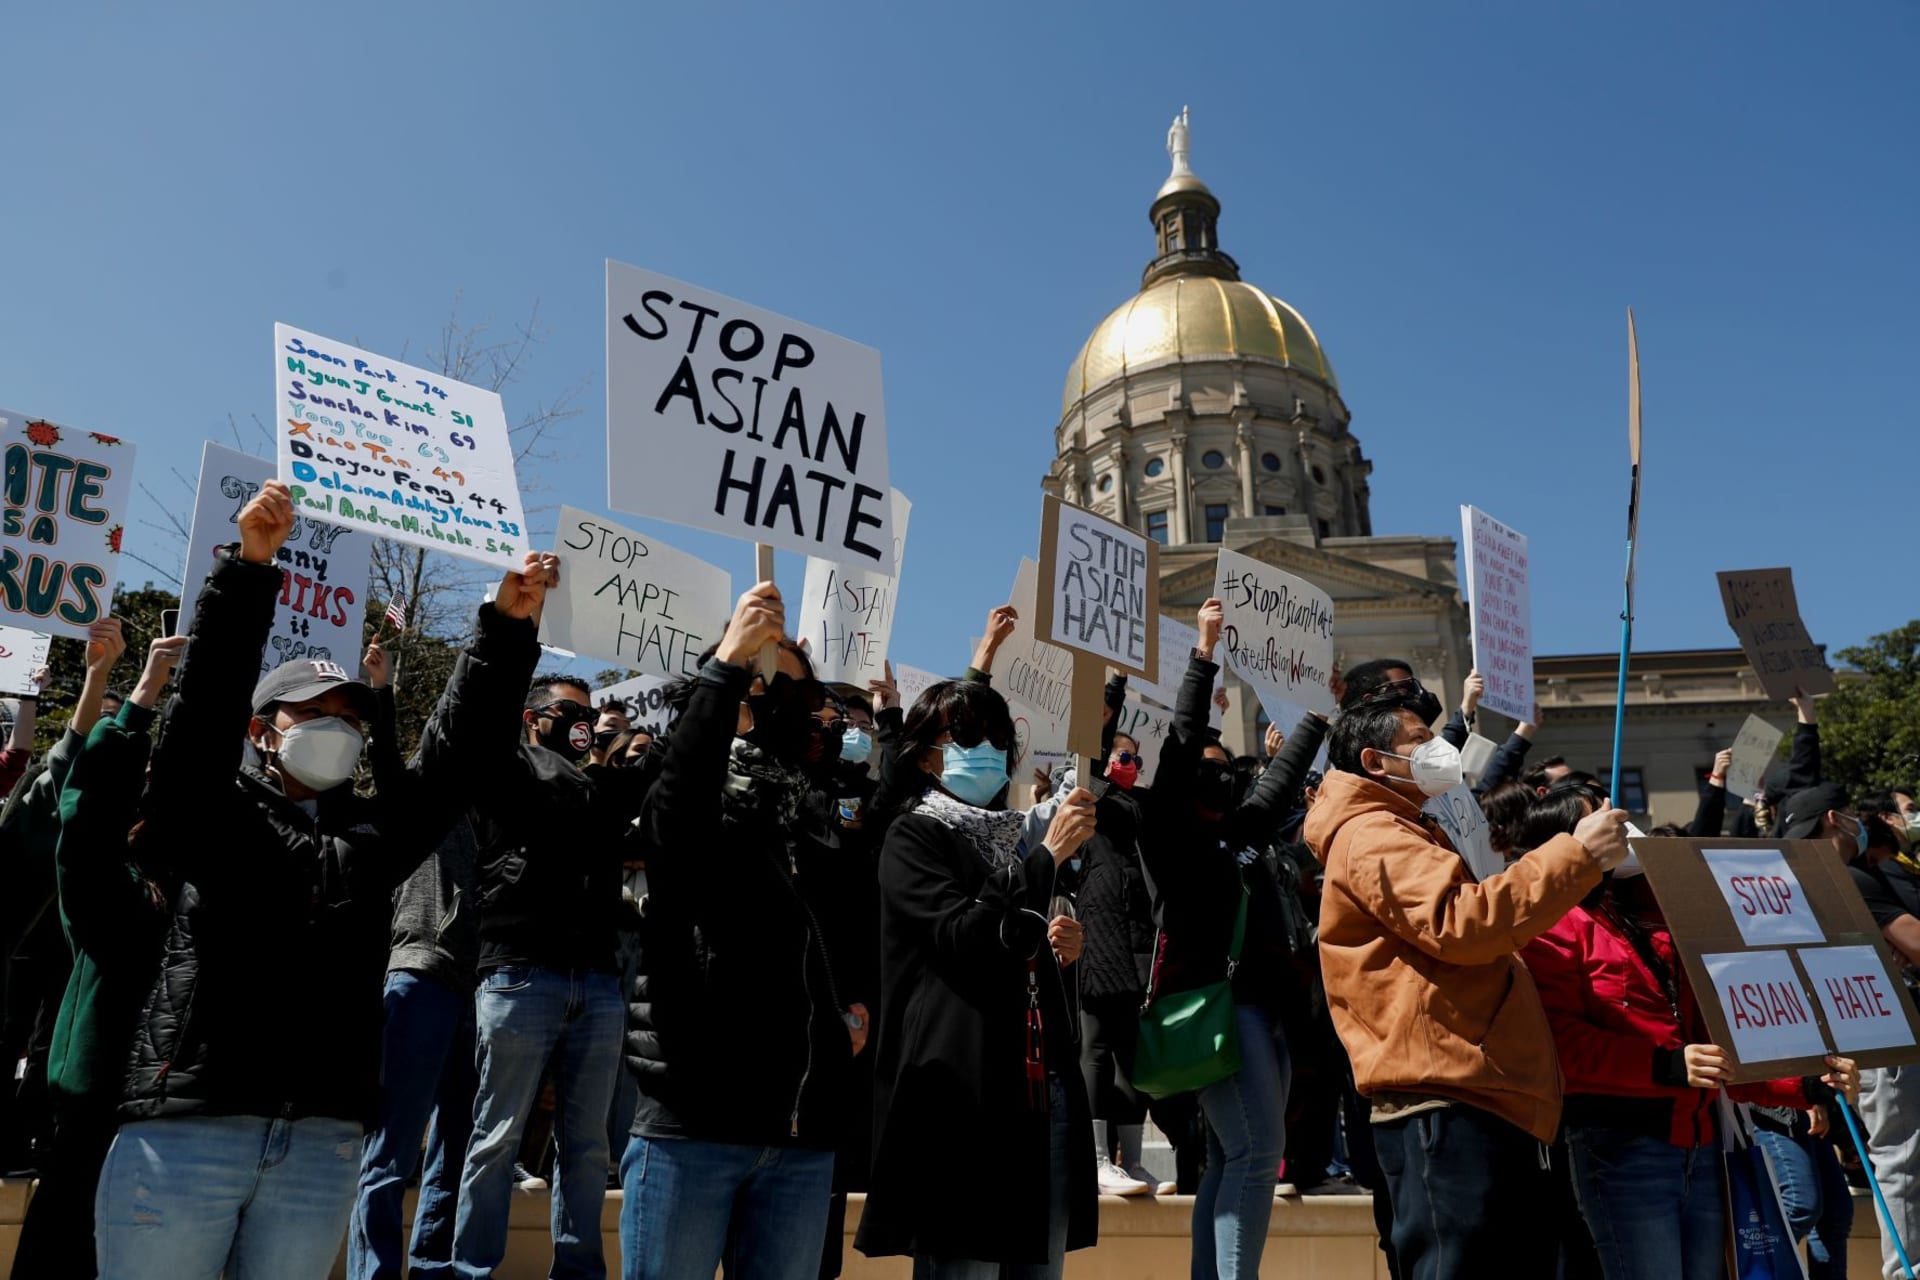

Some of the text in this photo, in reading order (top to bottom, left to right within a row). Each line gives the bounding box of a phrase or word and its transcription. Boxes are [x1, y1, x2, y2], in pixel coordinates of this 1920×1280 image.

[623, 290, 815, 381] STOP
[285, 338, 347, 367] Soon
[415, 380, 448, 400] 74
[287, 356, 351, 389] Hyun
[451, 410, 473, 428] 51
[288, 380, 378, 421] Suncha
[450, 431, 475, 450] 69
[288, 400, 345, 436] Yong
[418, 442, 449, 464] 63
[654, 355, 866, 474] ASIAN
[5, 443, 111, 525] ATE
[287, 418, 356, 451] Xiao
[432, 466, 465, 486] 49
[290, 440, 386, 476] Daoyou
[468, 493, 508, 515] 44
[28, 512, 58, 546] A
[290, 484, 332, 512] Paul
[485, 538, 514, 556] 54
[498, 520, 520, 536] 33
[714, 449, 884, 561] HATE
[276, 546, 327, 581] any
[564, 522, 648, 568] STOP
[1069, 522, 1146, 583] STOP
[0, 546, 106, 628] RUS
[594, 573, 679, 620] AAPI
[823, 569, 893, 628] ASIAN
[1061, 560, 1143, 619] ASIAN
[1222, 569, 1333, 640] #StopAsianHate
[290, 616, 309, 638] it
[616, 613, 702, 677] HATE
[823, 620, 880, 671] HATE
[1063, 594, 1144, 663] HATE
[1221, 624, 1326, 692] ProtectAsianWomen
[1730, 876, 1792, 916] STOP
[1728, 975, 1891, 1030] ASIAN HATE
